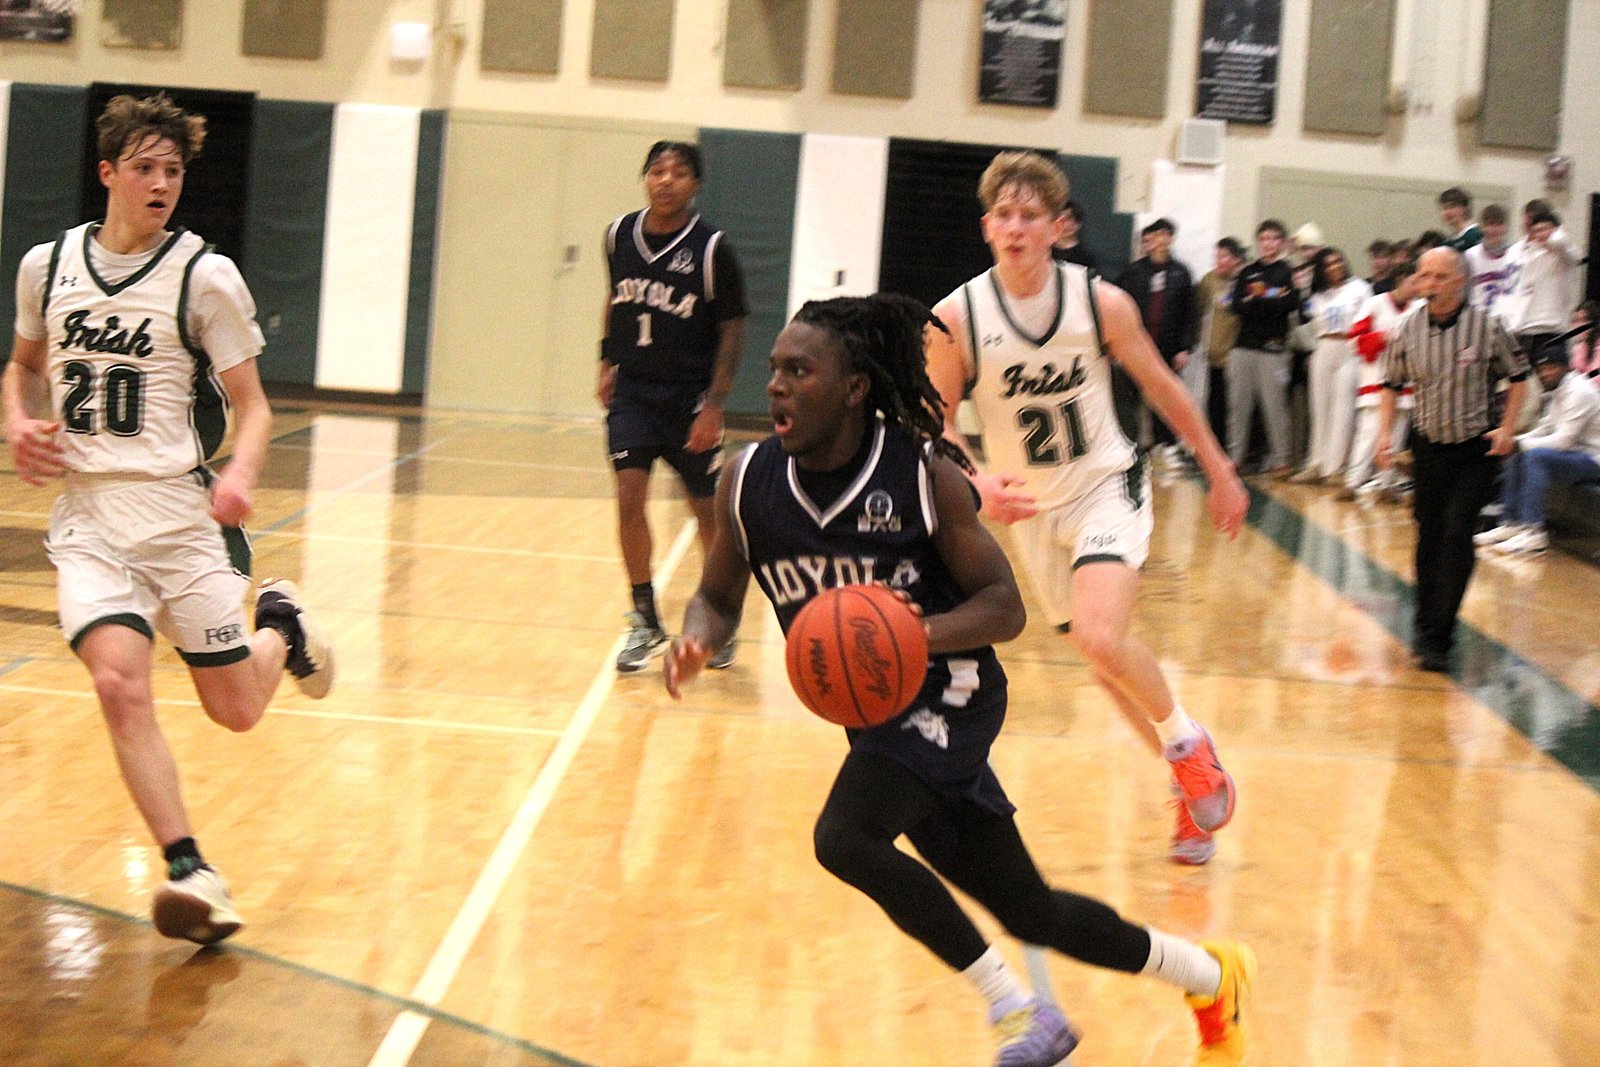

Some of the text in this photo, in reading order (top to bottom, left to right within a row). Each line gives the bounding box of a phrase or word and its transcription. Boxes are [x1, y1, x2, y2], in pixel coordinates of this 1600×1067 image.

[58, 310, 154, 357] Irish
[636, 313, 653, 346] 1
[60, 360, 147, 437] 20
[1002, 354, 1088, 399] Irish
[1017, 396, 1088, 468] 21
